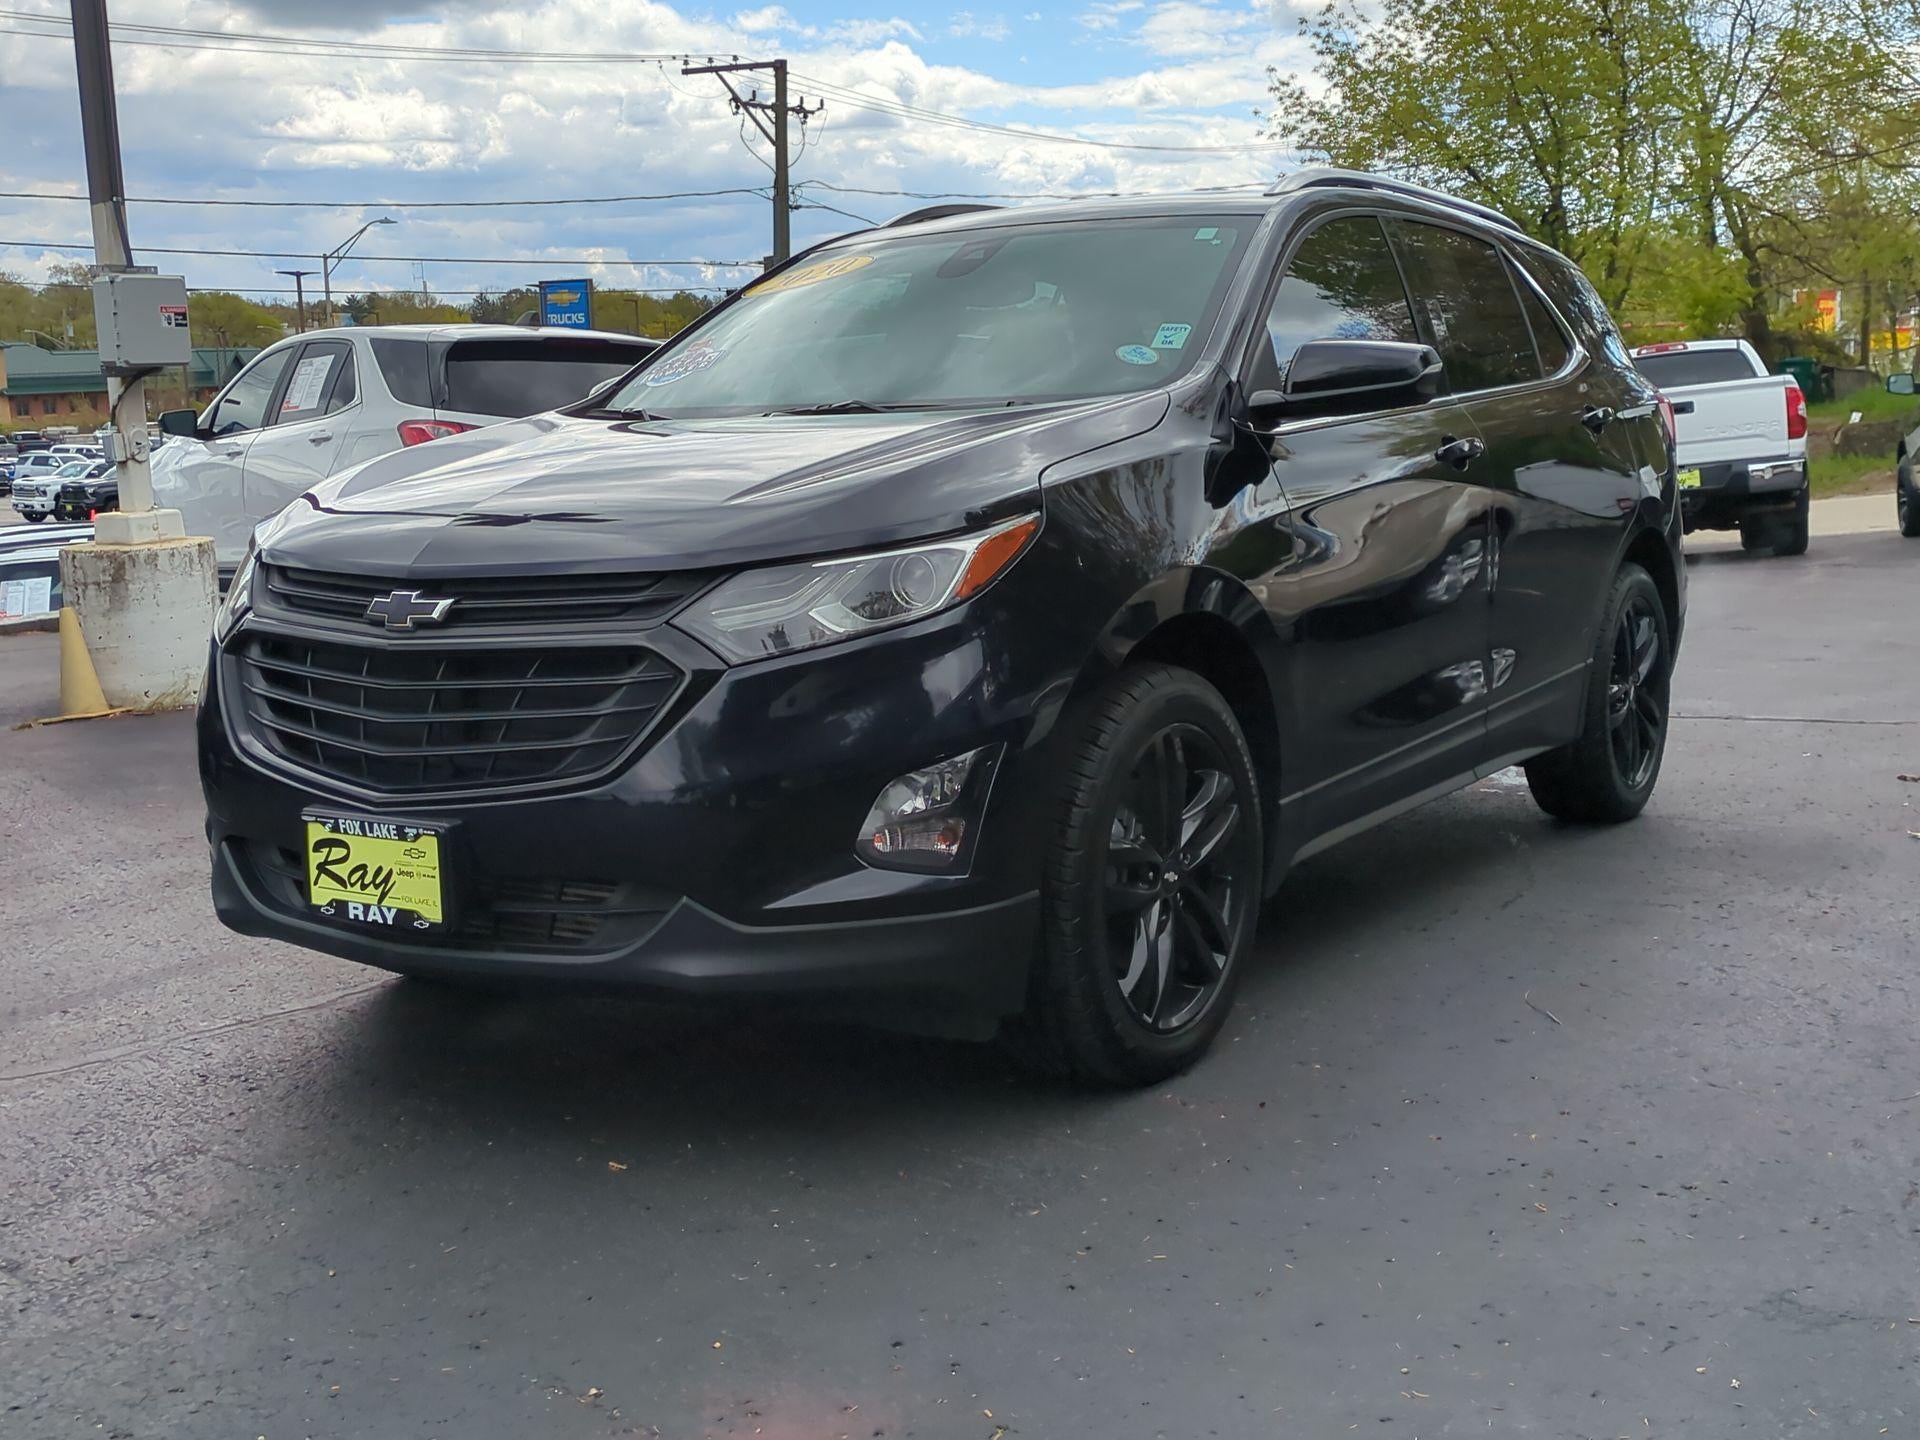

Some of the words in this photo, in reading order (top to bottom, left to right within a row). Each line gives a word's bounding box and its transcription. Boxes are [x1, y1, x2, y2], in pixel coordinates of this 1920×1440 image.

[547, 312, 585, 324] TRUCKS
[1160, 325, 1189, 333] SAFETY
[338, 818, 362, 836] FOX
[364, 821, 399, 840] LAKE
[312, 837, 396, 905] Ray
[396, 867, 415, 879] Jeep
[348, 901, 398, 925] RAY
